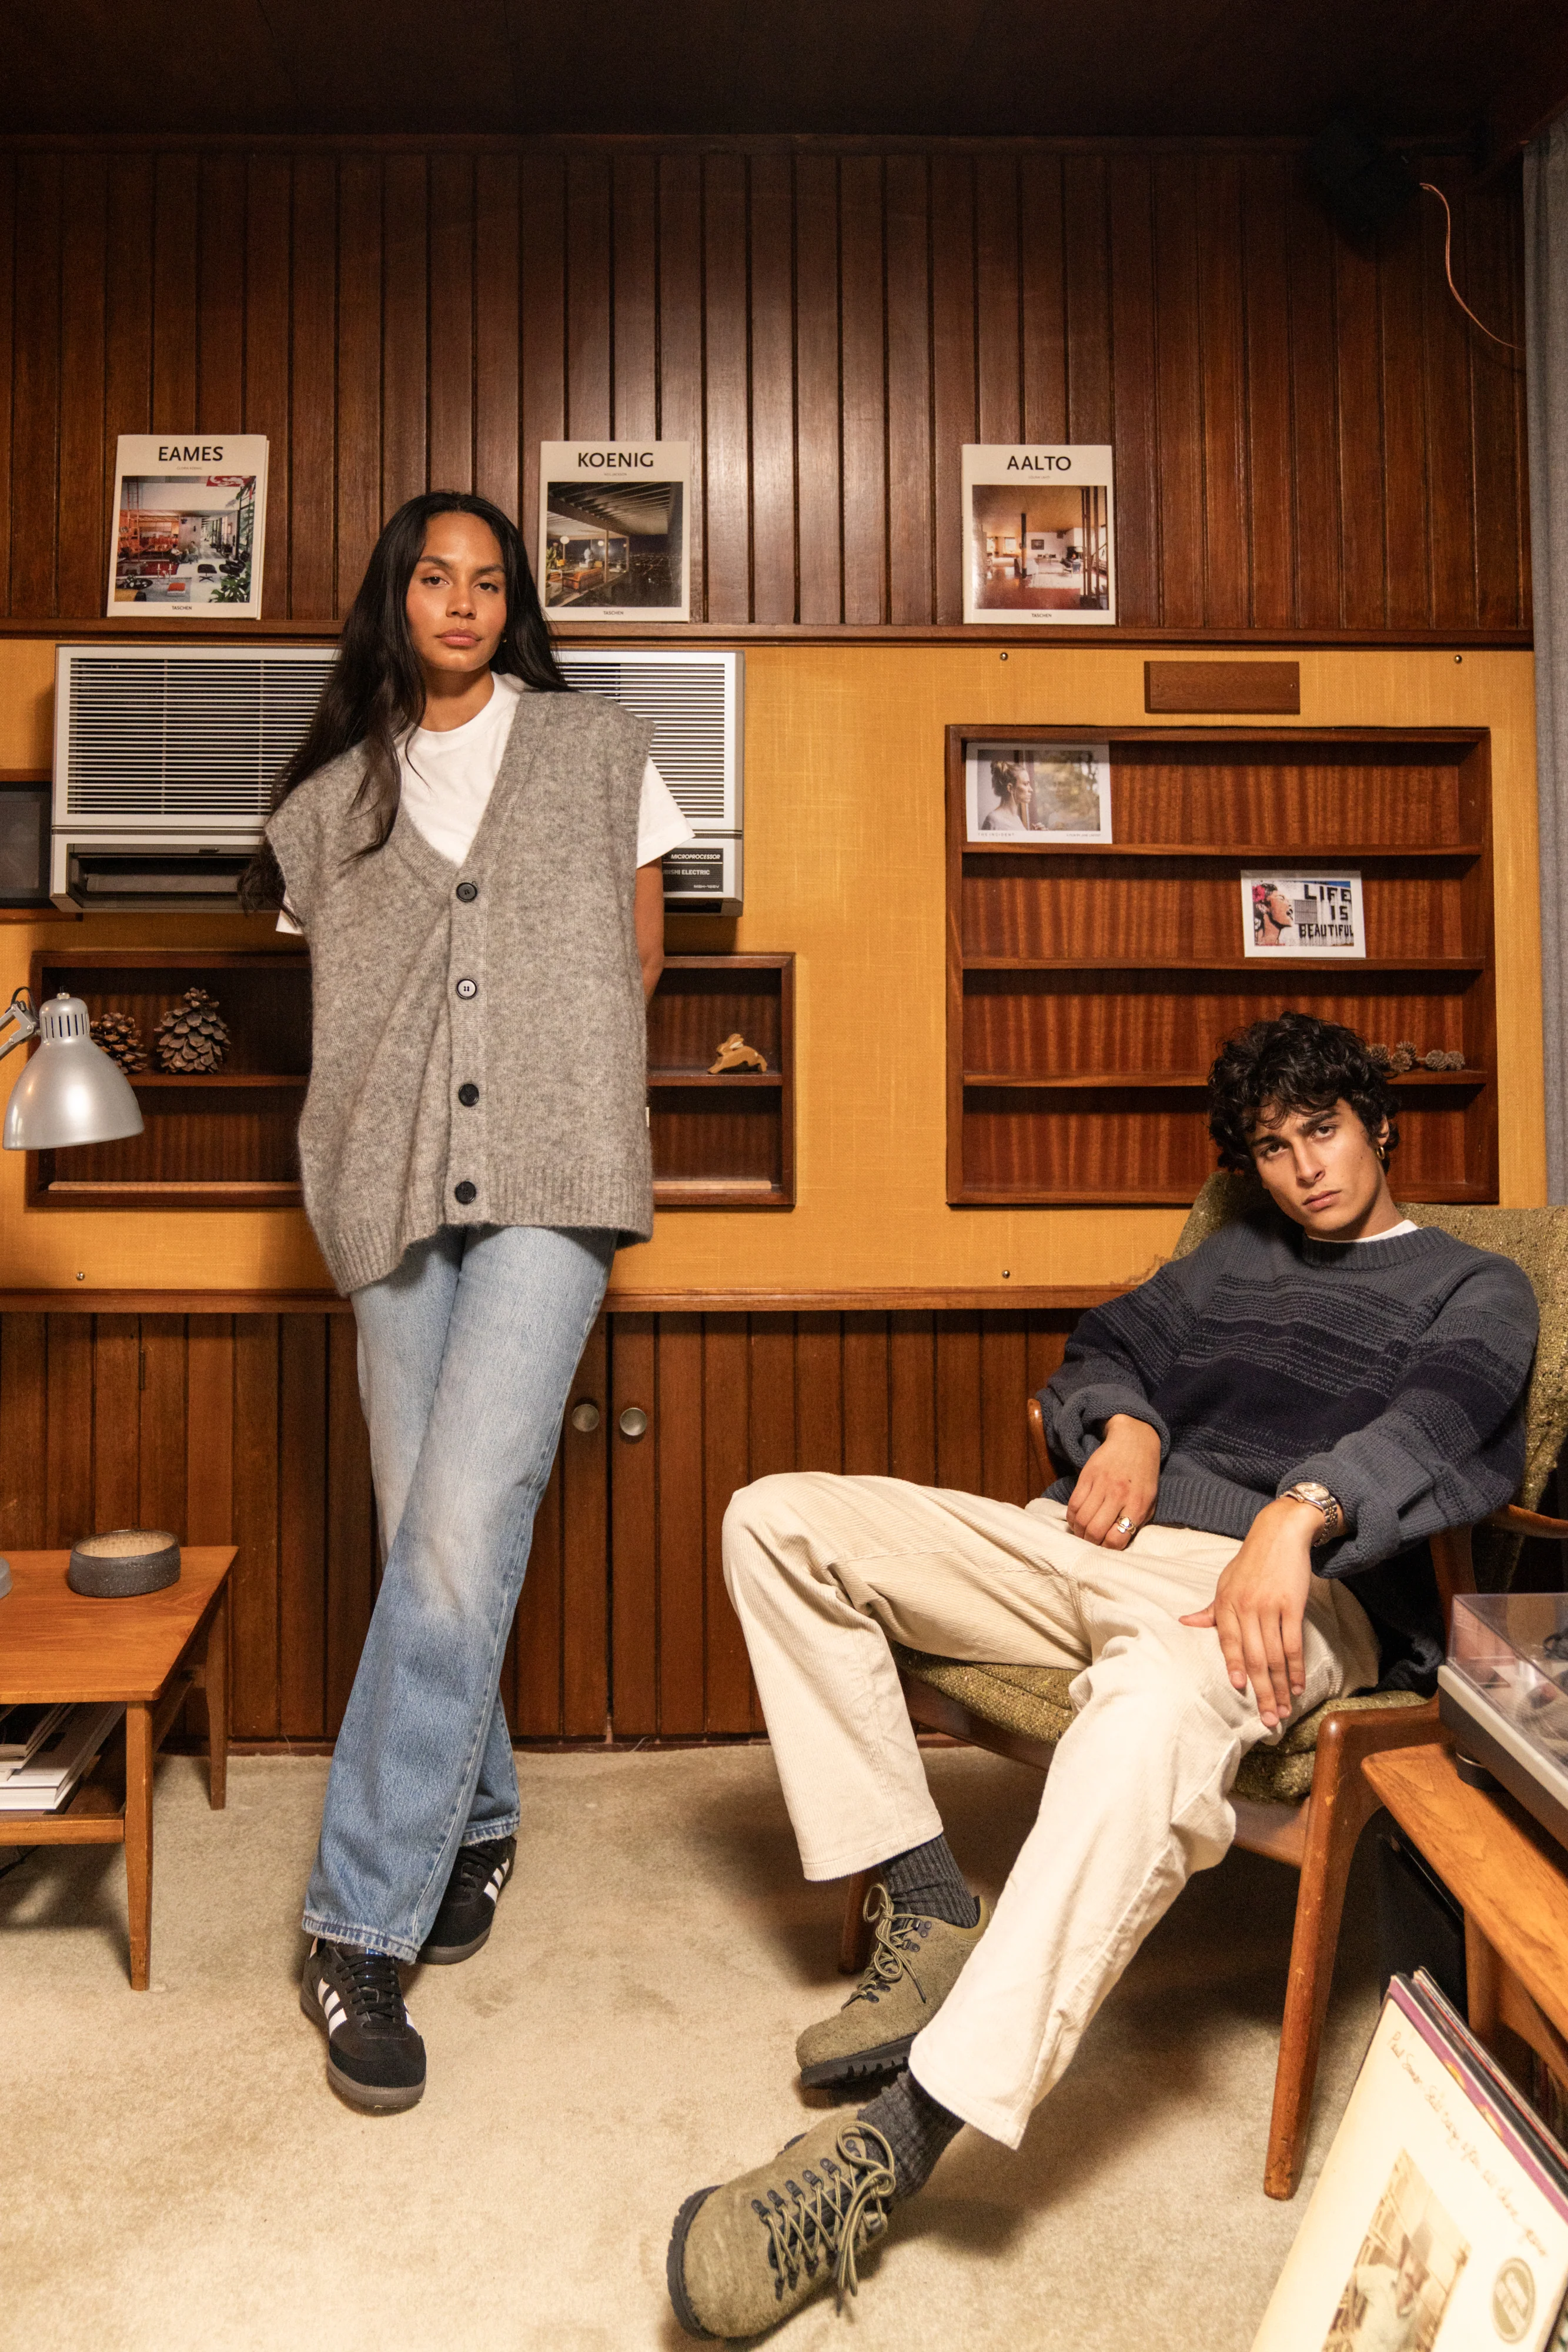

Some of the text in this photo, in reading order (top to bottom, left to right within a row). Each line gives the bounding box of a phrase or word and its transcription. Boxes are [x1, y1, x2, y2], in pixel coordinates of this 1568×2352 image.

[158, 446, 224, 462] EAMES
[578, 452, 654, 467] KOENIG
[1007, 456, 1072, 471] AALTO
[1304, 884, 1352, 903] LIFE
[1330, 906, 1348, 920] IS
[1299, 923, 1354, 939] BEAUTIFUL
